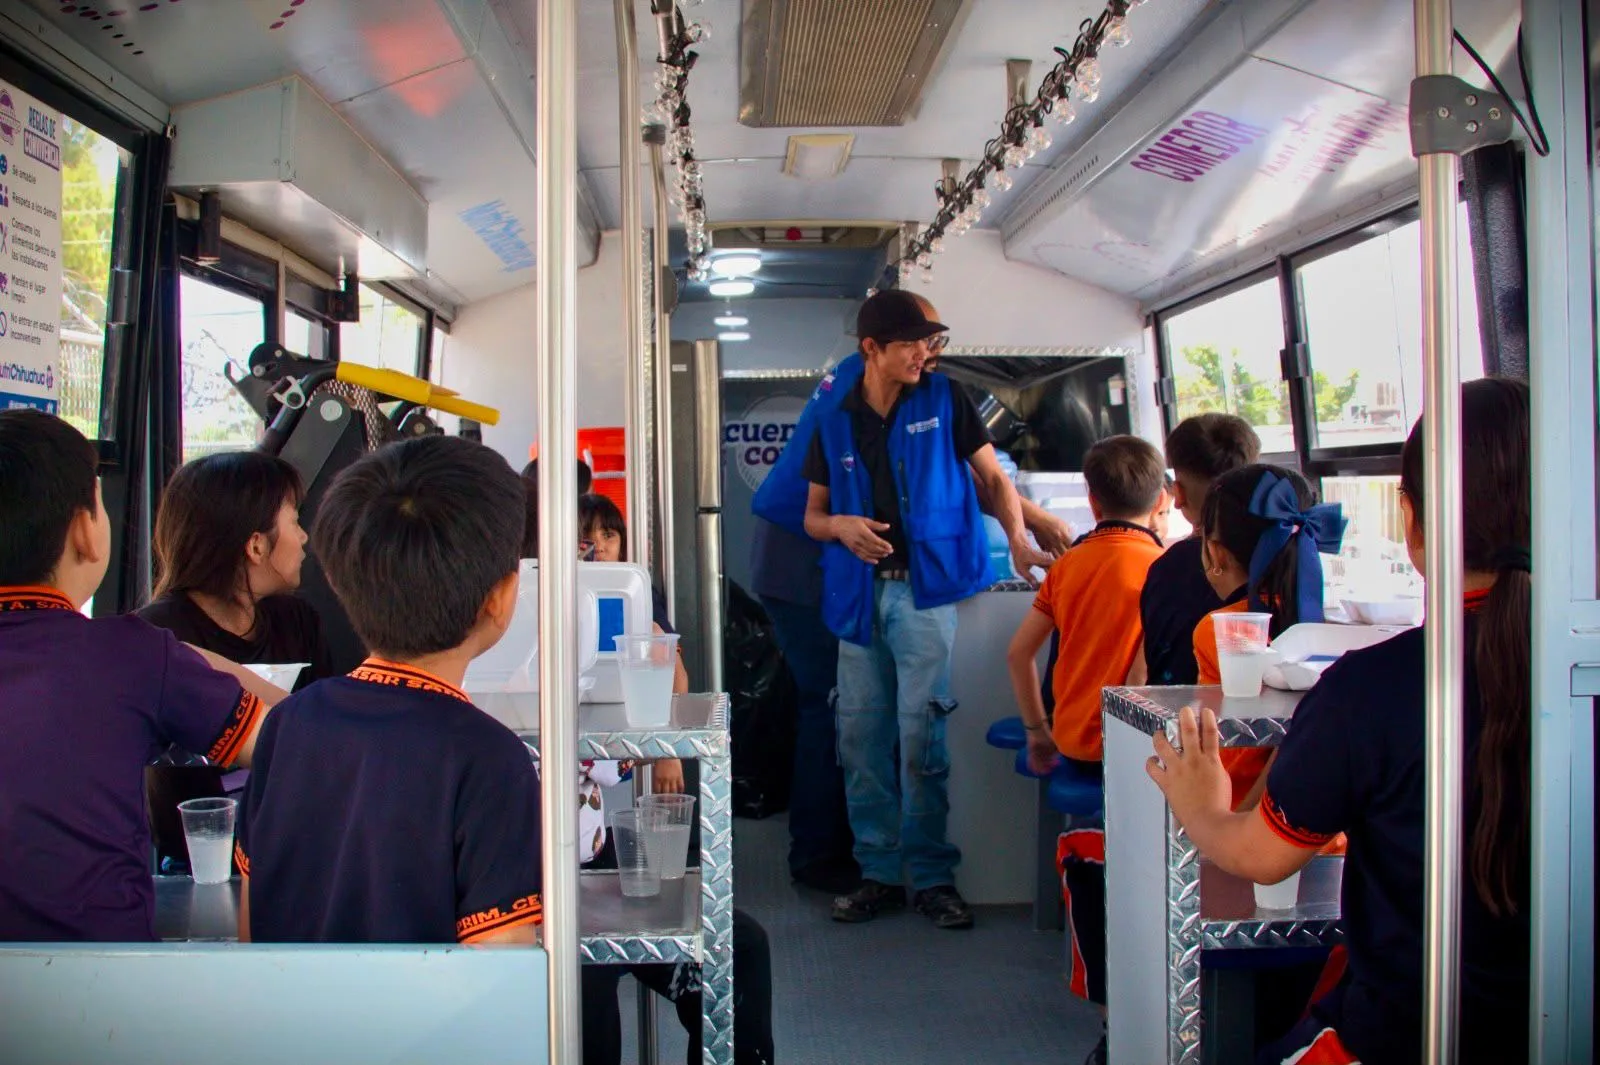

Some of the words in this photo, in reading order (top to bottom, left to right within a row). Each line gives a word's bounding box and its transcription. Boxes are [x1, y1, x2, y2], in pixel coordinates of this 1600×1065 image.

[29, 106, 48, 135] REGLAS
[49, 118, 56, 140] DE
[1130, 110, 1269, 183] COMEDOR
[20, 170, 36, 184] amable
[12, 192, 31, 209] Respeta
[12, 218, 33, 234] Consume
[12, 235, 34, 250] alimentos
[35, 243, 50, 257] dentro
[20, 254, 48, 272] instalaciones
[34, 282, 46, 295] lugar
[19, 316, 33, 327] entrar
[39, 321, 54, 333] estado
[11, 330, 41, 345] inconveniente
[0, 362, 45, 385] utriChihuahua
[744, 446, 783, 465] co
[207, 724, 237, 759] RIM.
[456, 907, 507, 932] PRIM.
[512, 893, 542, 910] CE
